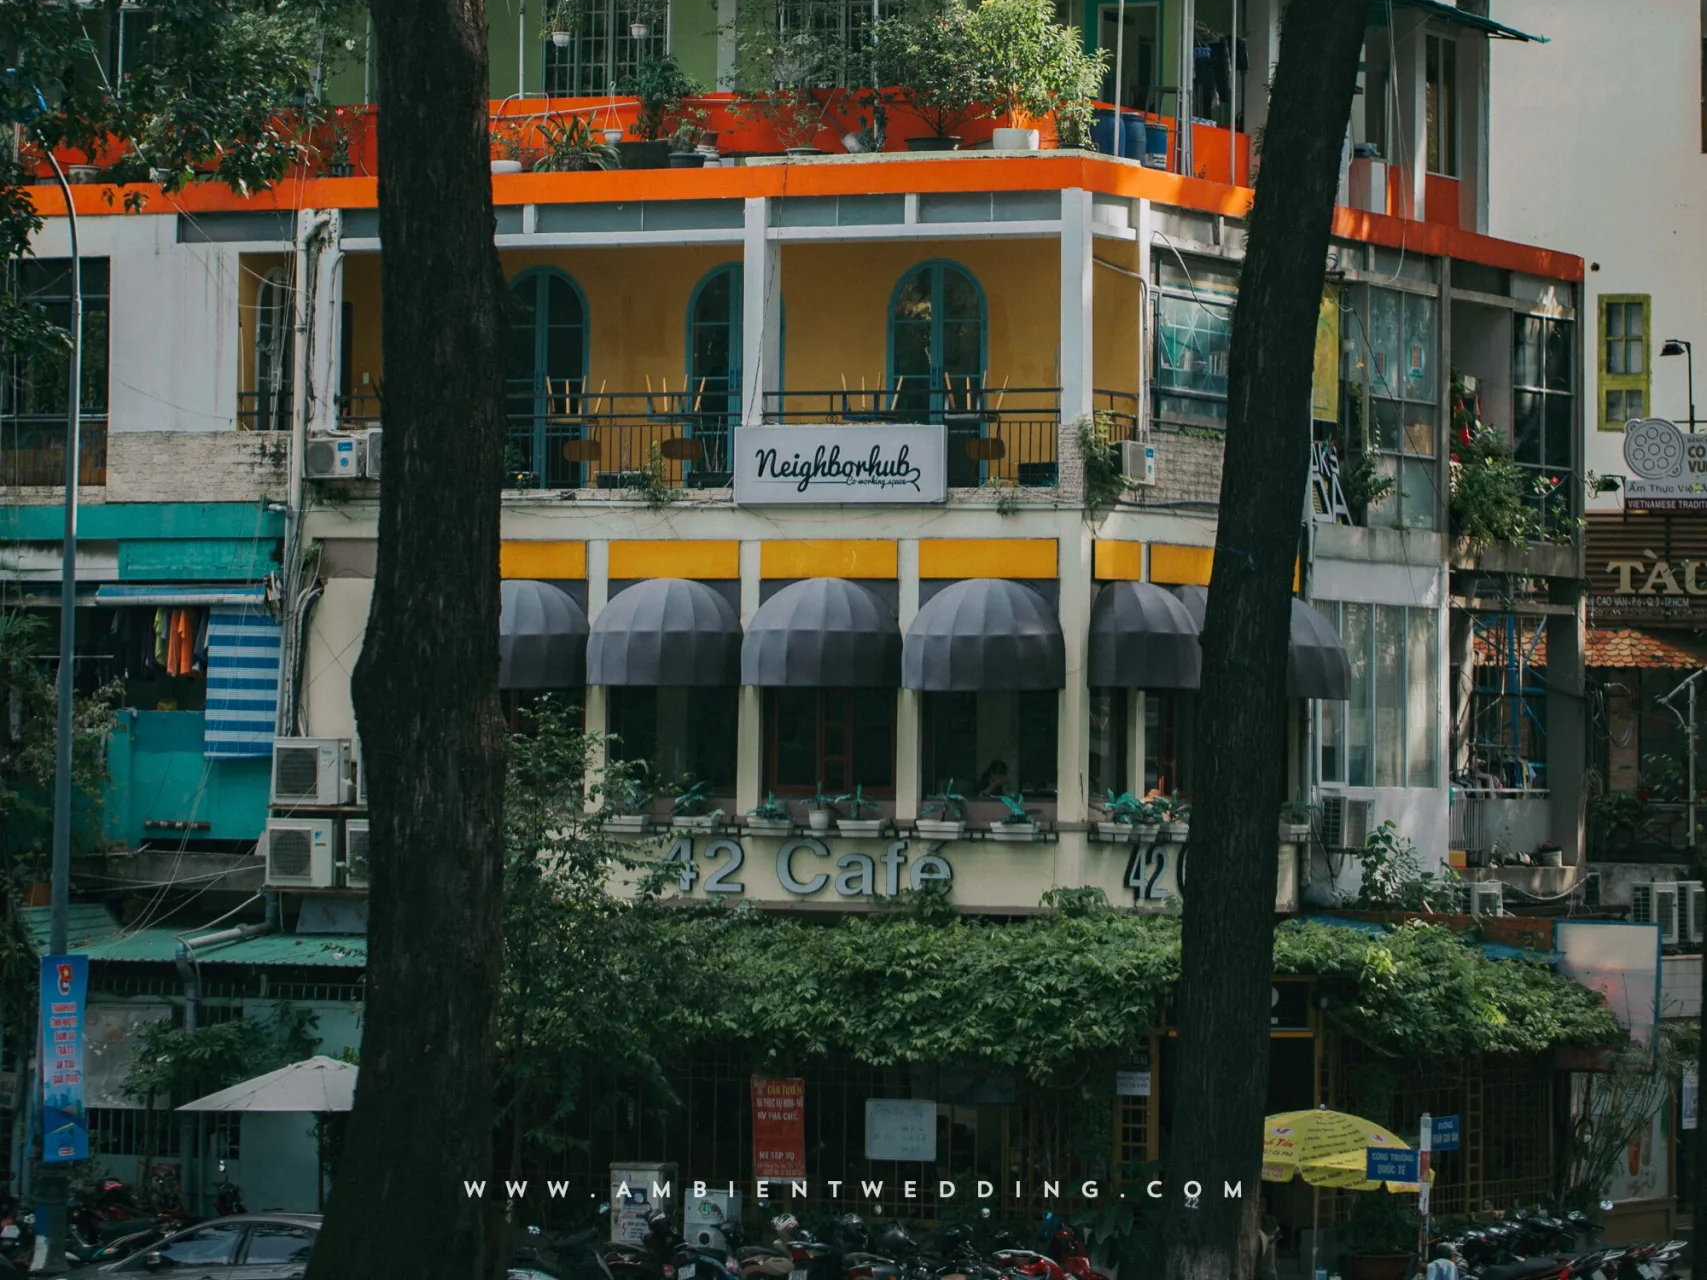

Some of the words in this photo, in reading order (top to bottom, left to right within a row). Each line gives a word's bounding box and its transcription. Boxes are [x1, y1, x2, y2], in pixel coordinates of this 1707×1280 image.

[755, 444, 921, 493] Neighborhub
[886, 478, 906, 488] space
[1628, 499, 1677, 508] VIETNAMESE
[664, 836, 745, 893] 42
[776, 837, 954, 897] Café
[1124, 844, 1170, 899] 42
